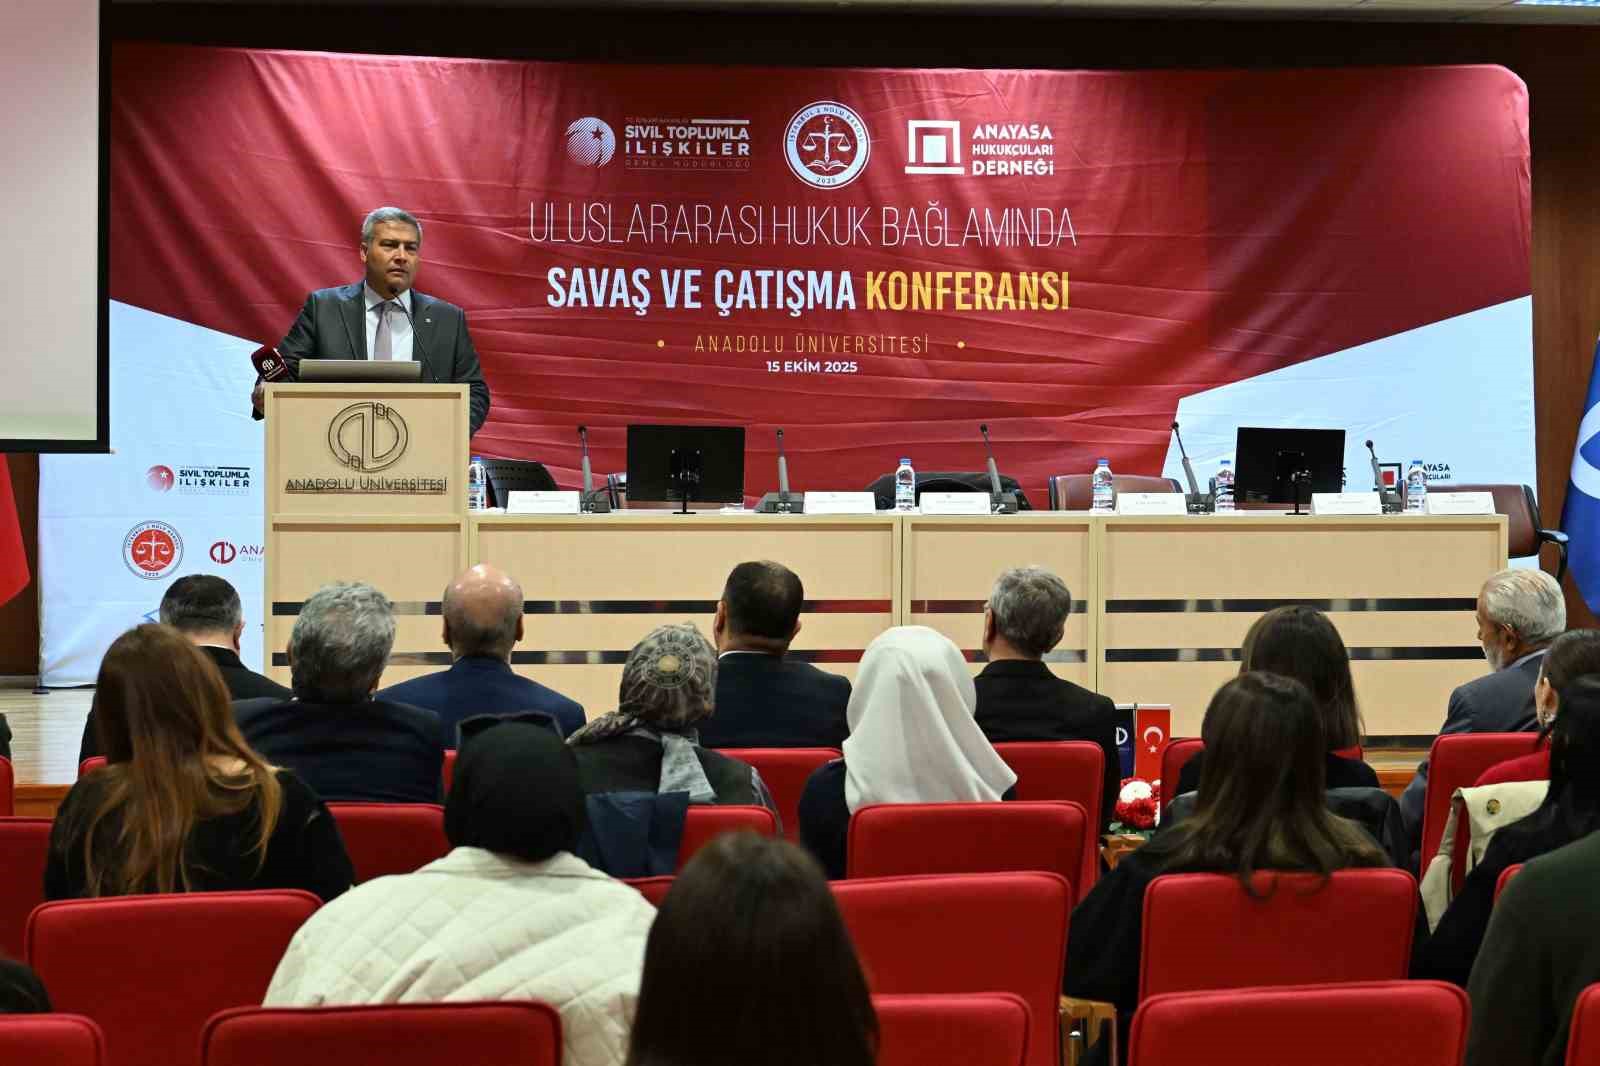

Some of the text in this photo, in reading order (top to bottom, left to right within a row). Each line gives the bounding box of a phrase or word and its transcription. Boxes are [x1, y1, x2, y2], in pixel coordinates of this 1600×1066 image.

[624, 125, 750, 140] SİVİL TOPLUMLA
[972, 124, 1053, 140] ANAYASA
[625, 141, 750, 156] İLİŞKİLER
[972, 144, 1054, 157] HUKUKÇULARI
[972, 158, 1055, 176] DERNEĞİ
[529, 200, 1078, 247] ULUSLARARASI HUKUK BAĞLAMINDA
[547, 266, 1070, 317] SAVAŞ VE ÇATIŞMA KONFERANSI
[694, 332, 929, 354] ANADOLU ÜNİVERSİTESİ
[766, 358, 858, 374] 15 EKİM 2025
[203, 470, 250, 479] TOPLUMLA
[285, 475, 447, 491] ANADOLU ÜNİVERSİTESİ
